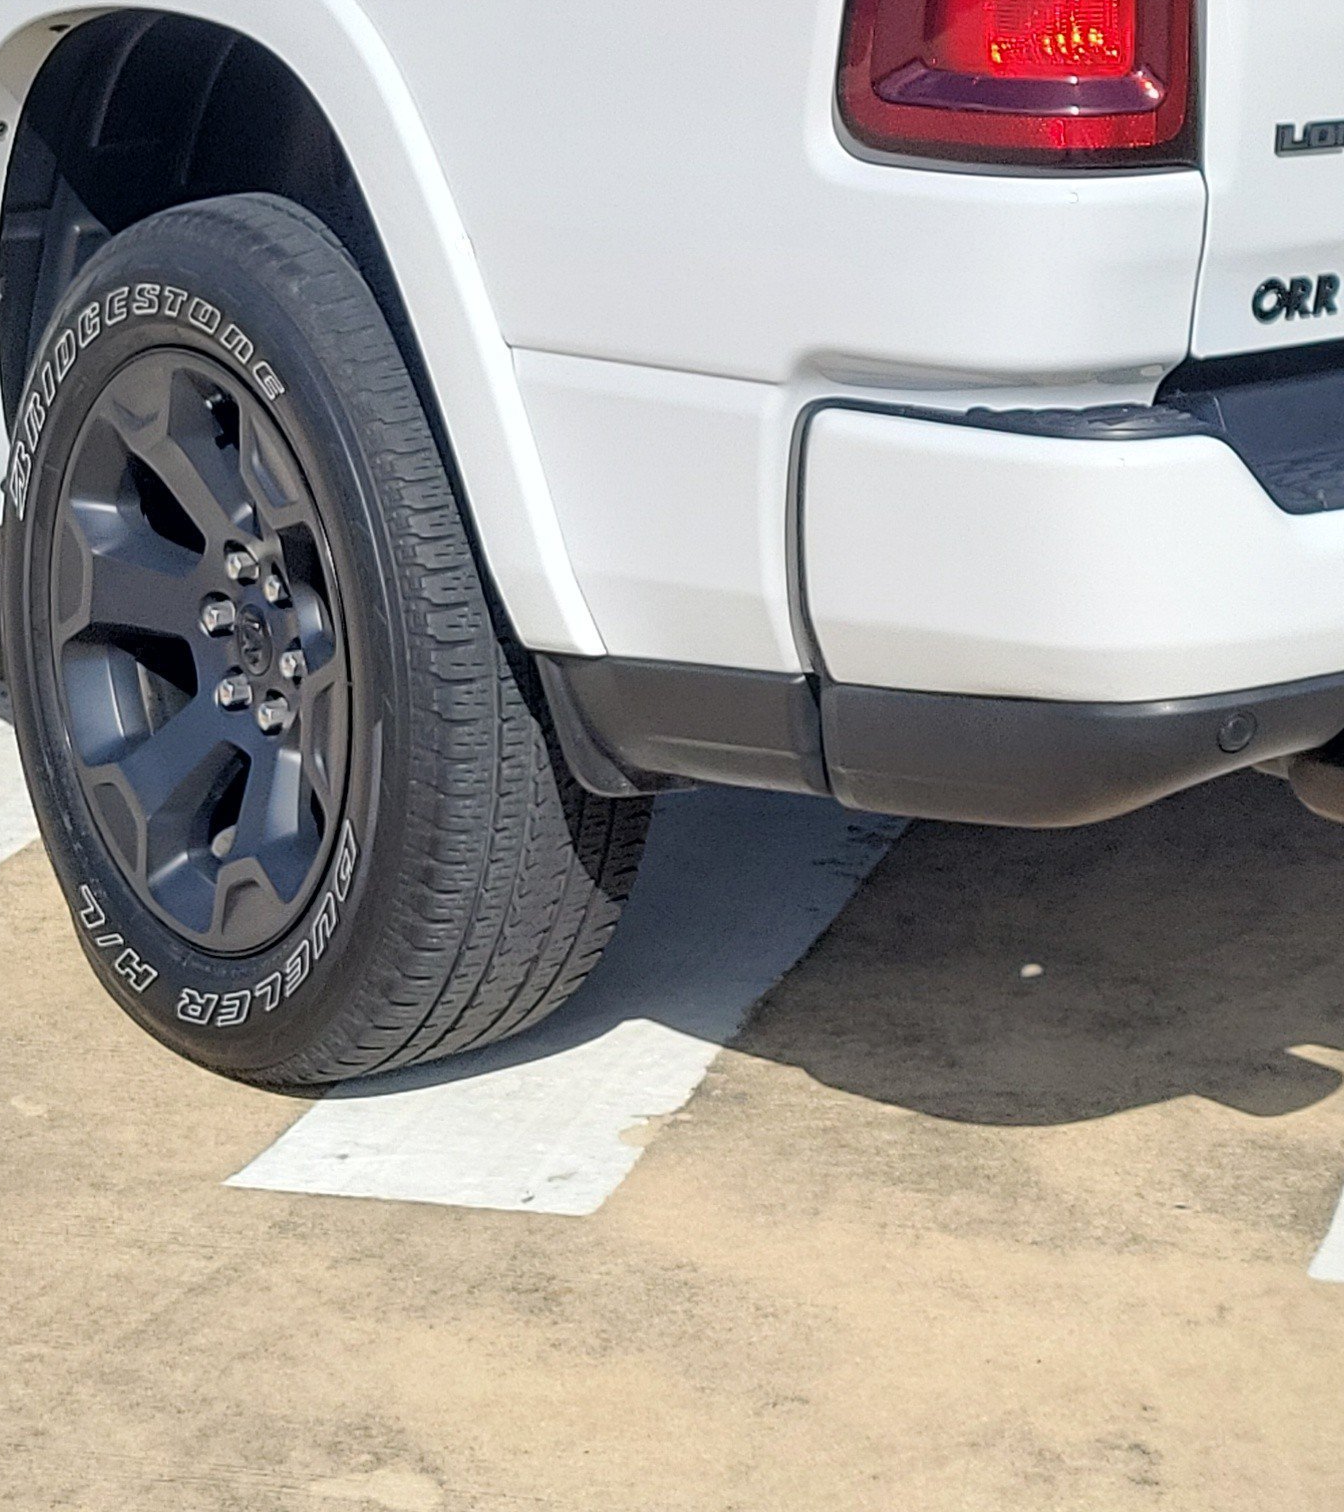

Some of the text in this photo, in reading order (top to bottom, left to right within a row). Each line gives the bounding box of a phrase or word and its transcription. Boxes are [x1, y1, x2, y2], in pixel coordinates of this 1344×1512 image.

[9, 283, 286, 521] BRIDGESTONE
[1251, 272, 1340, 325] ORR
[81, 819, 359, 1027] DUELER H/L
